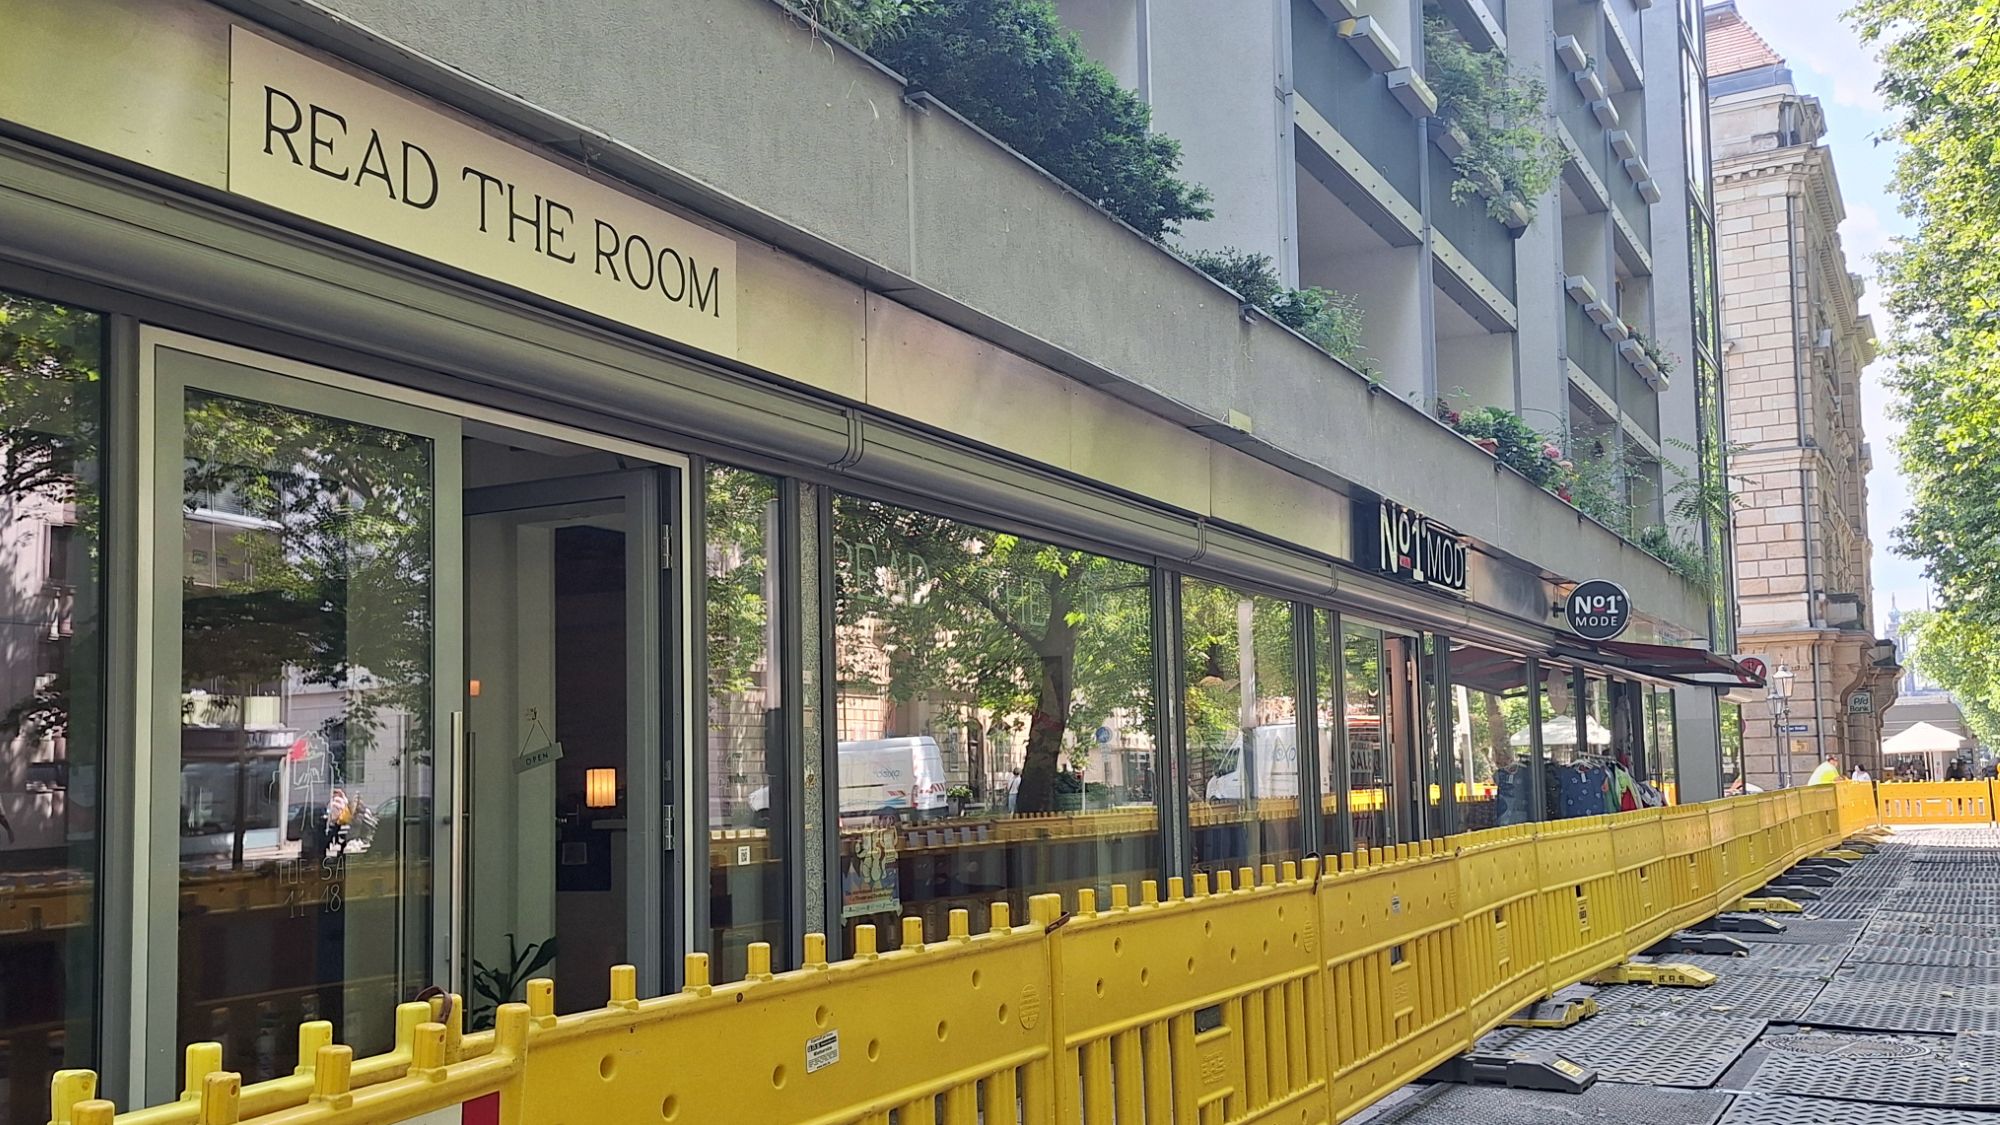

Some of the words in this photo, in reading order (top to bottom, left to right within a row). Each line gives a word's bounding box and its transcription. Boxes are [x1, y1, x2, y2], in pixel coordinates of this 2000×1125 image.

[263, 85, 438, 209] READ
[462, 166, 576, 264] THE
[594, 218, 720, 318] ROOM
[1575, 616, 1618, 627] MODE
[525, 751, 549, 766] OPEN
[320, 883, 342, 912] 18
